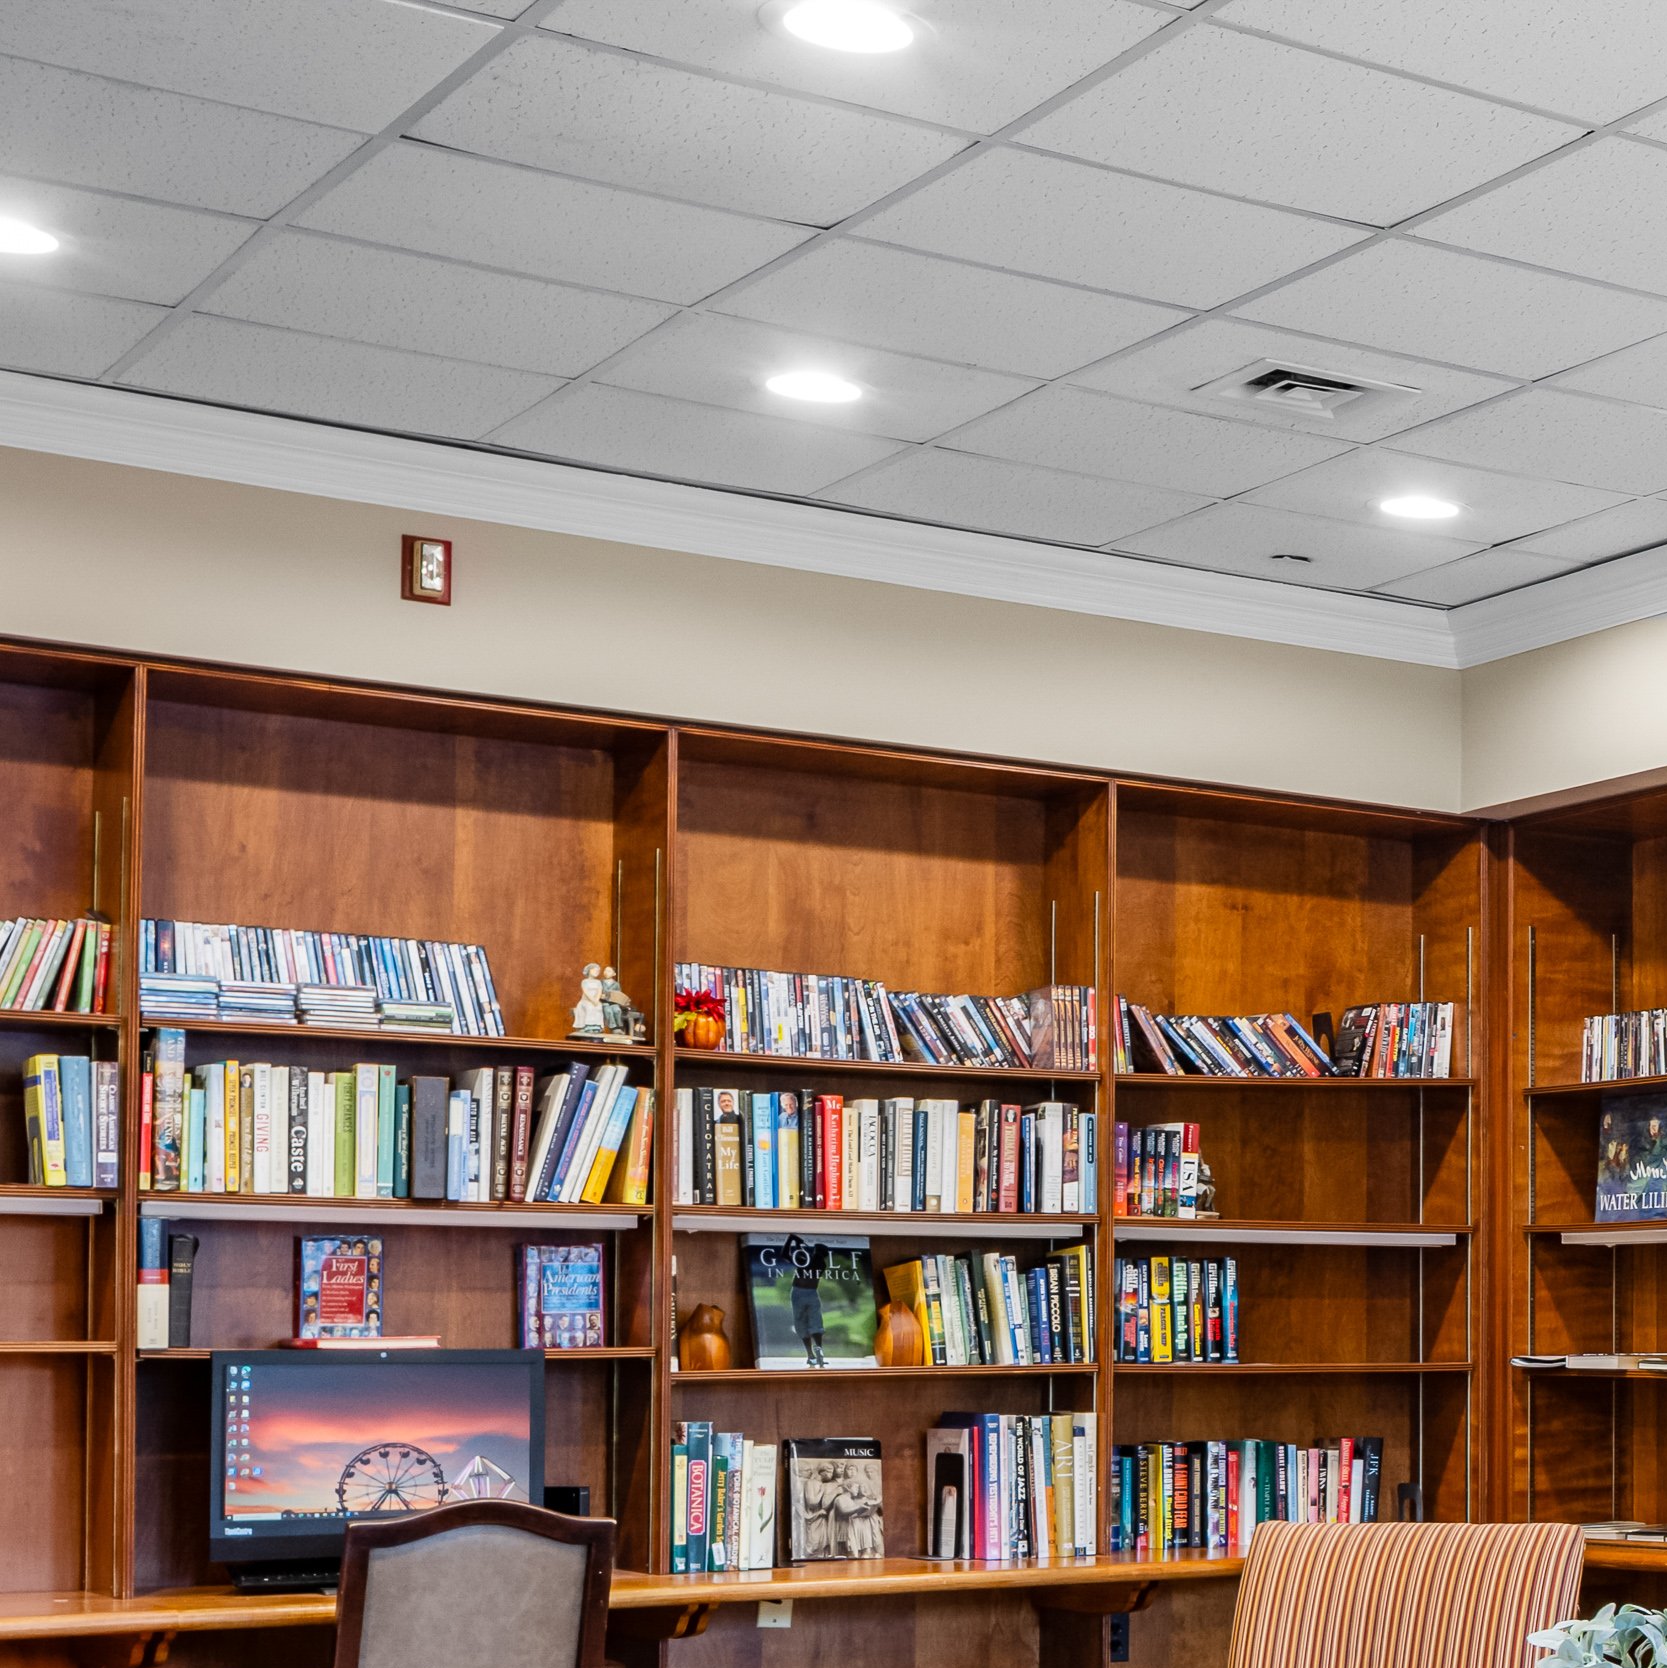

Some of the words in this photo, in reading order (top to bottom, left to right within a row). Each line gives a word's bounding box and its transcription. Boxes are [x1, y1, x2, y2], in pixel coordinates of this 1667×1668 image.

[256, 1114, 270, 1152] GIVING
[291, 1126, 307, 1172] Caste
[704, 1103, 712, 1189] CLEOPATRA
[720, 1147, 737, 1161] My
[718, 1159, 739, 1170] Life
[1183, 1160, 1195, 1192] USA
[1600, 1193, 1638, 1211] WATER
[760, 1248, 862, 1269] GOLF
[323, 1271, 364, 1283] Ladies
[768, 1268, 784, 1278] IN
[793, 1270, 860, 1280] AMERICA
[544, 1283, 597, 1295] Presidents
[1051, 1295, 1061, 1332] PICCOLO
[844, 1448, 874, 1457] MUSIC
[1018, 1466, 1024, 1475] OF
[690, 1464, 704, 1531] BOTANICA
[1018, 1477, 1026, 1500] JAZZ
